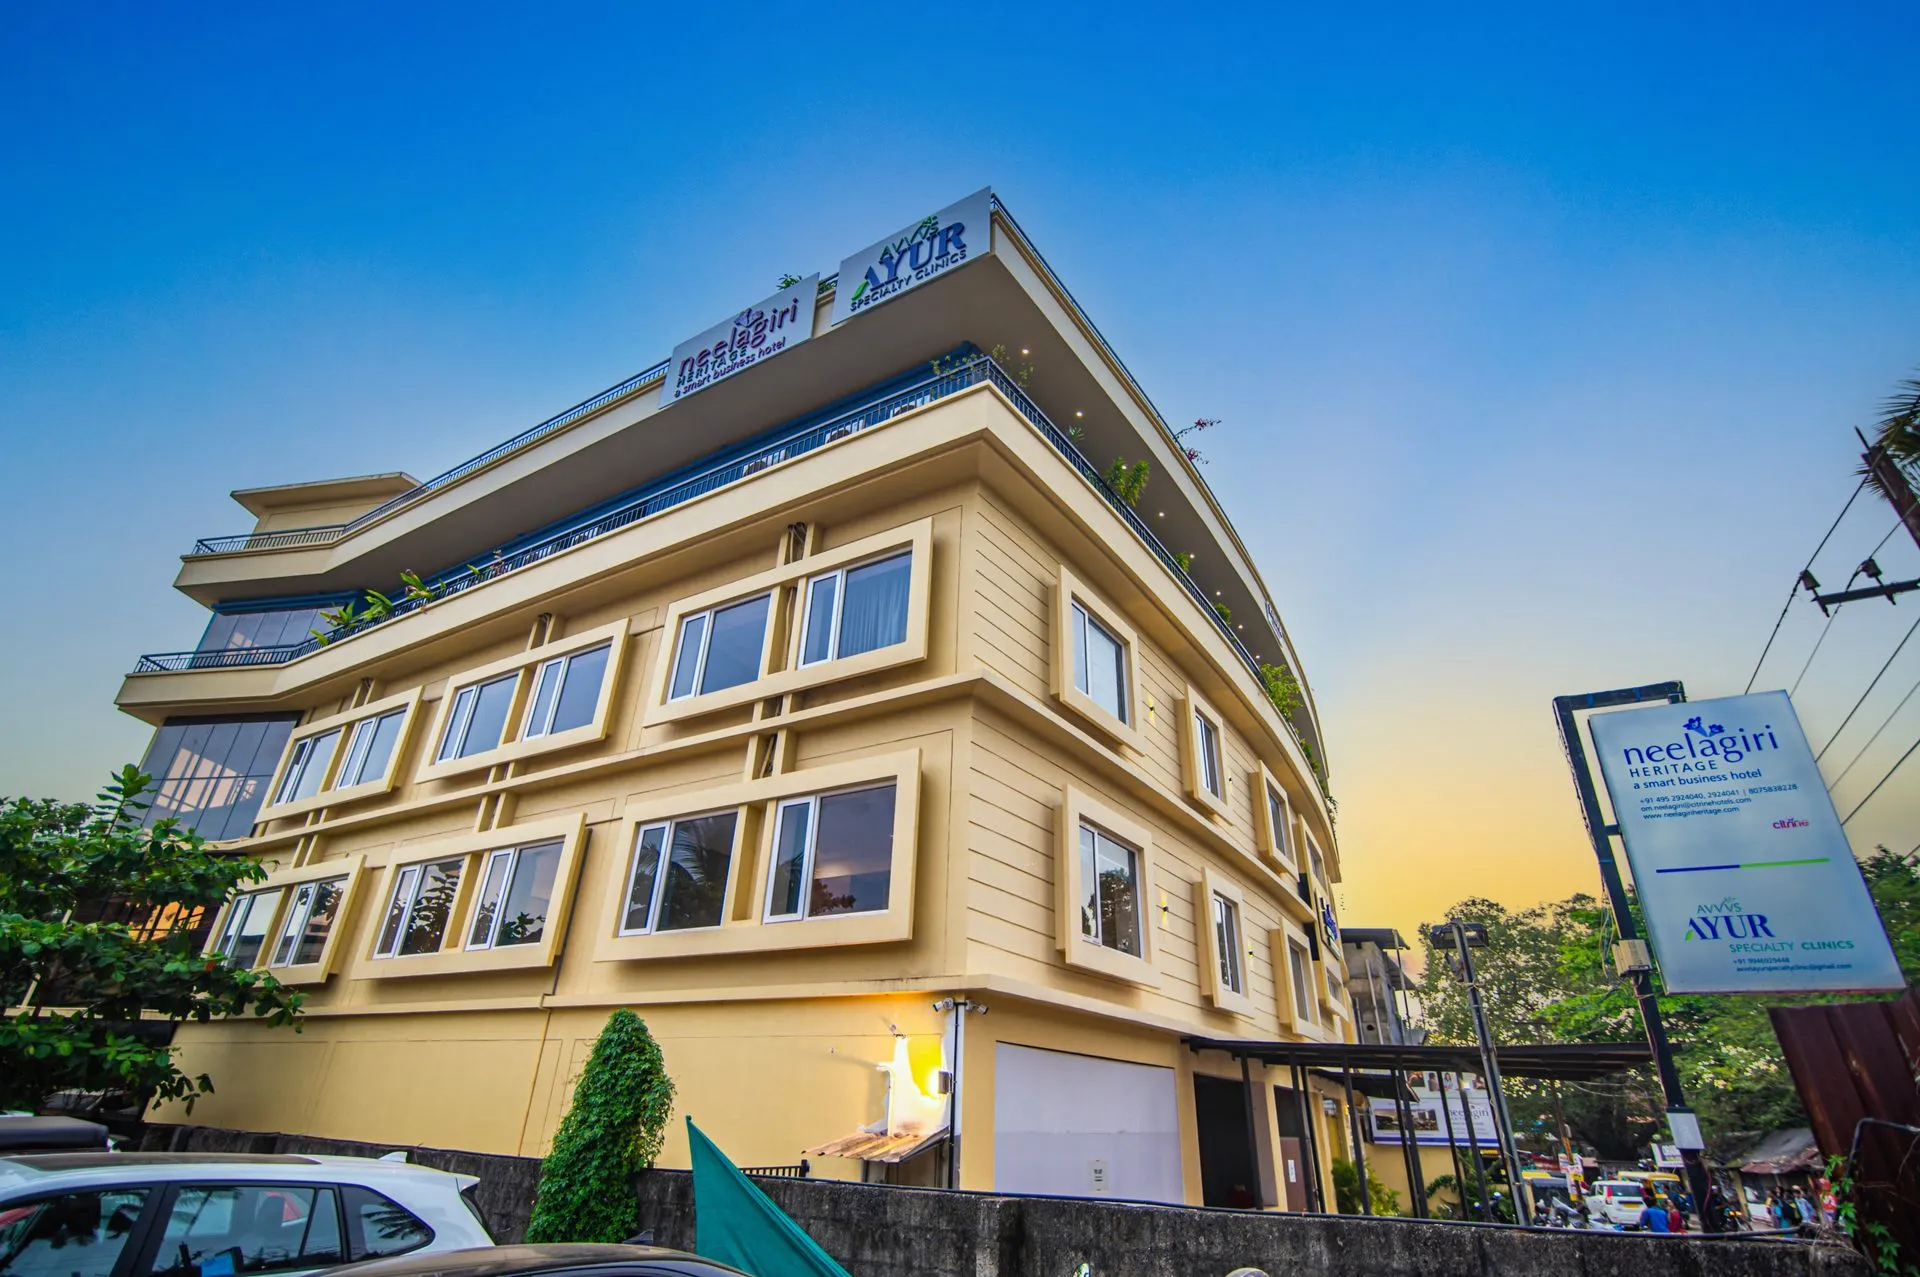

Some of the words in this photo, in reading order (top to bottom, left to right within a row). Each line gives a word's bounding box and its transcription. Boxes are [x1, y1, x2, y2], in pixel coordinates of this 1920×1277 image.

[850, 275, 912, 312] SPECIALTY
[915, 249, 967, 281] CLINICS
[852, 222, 967, 301] AYUR
[679, 298, 798, 378] neelagiri
[676, 345, 748, 388] HERITAGE
[682, 375, 711, 395] smart
[712, 353, 756, 381] business
[758, 336, 786, 359] hotel
[1624, 725, 1779, 765] neelagiri
[1629, 760, 1718, 778] HERITAGE
[1633, 782, 1640, 790] a
[1643, 776, 1676, 789] smart
[1678, 772, 1728, 786] business
[1730, 768, 1762, 780] hotel
[1708, 790, 1740, 799] 2924041
[1685, 914, 1776, 941] AYUR
[1729, 942, 1794, 953] SPECIALTY
[1801, 940, 1855, 951] CLINICS
